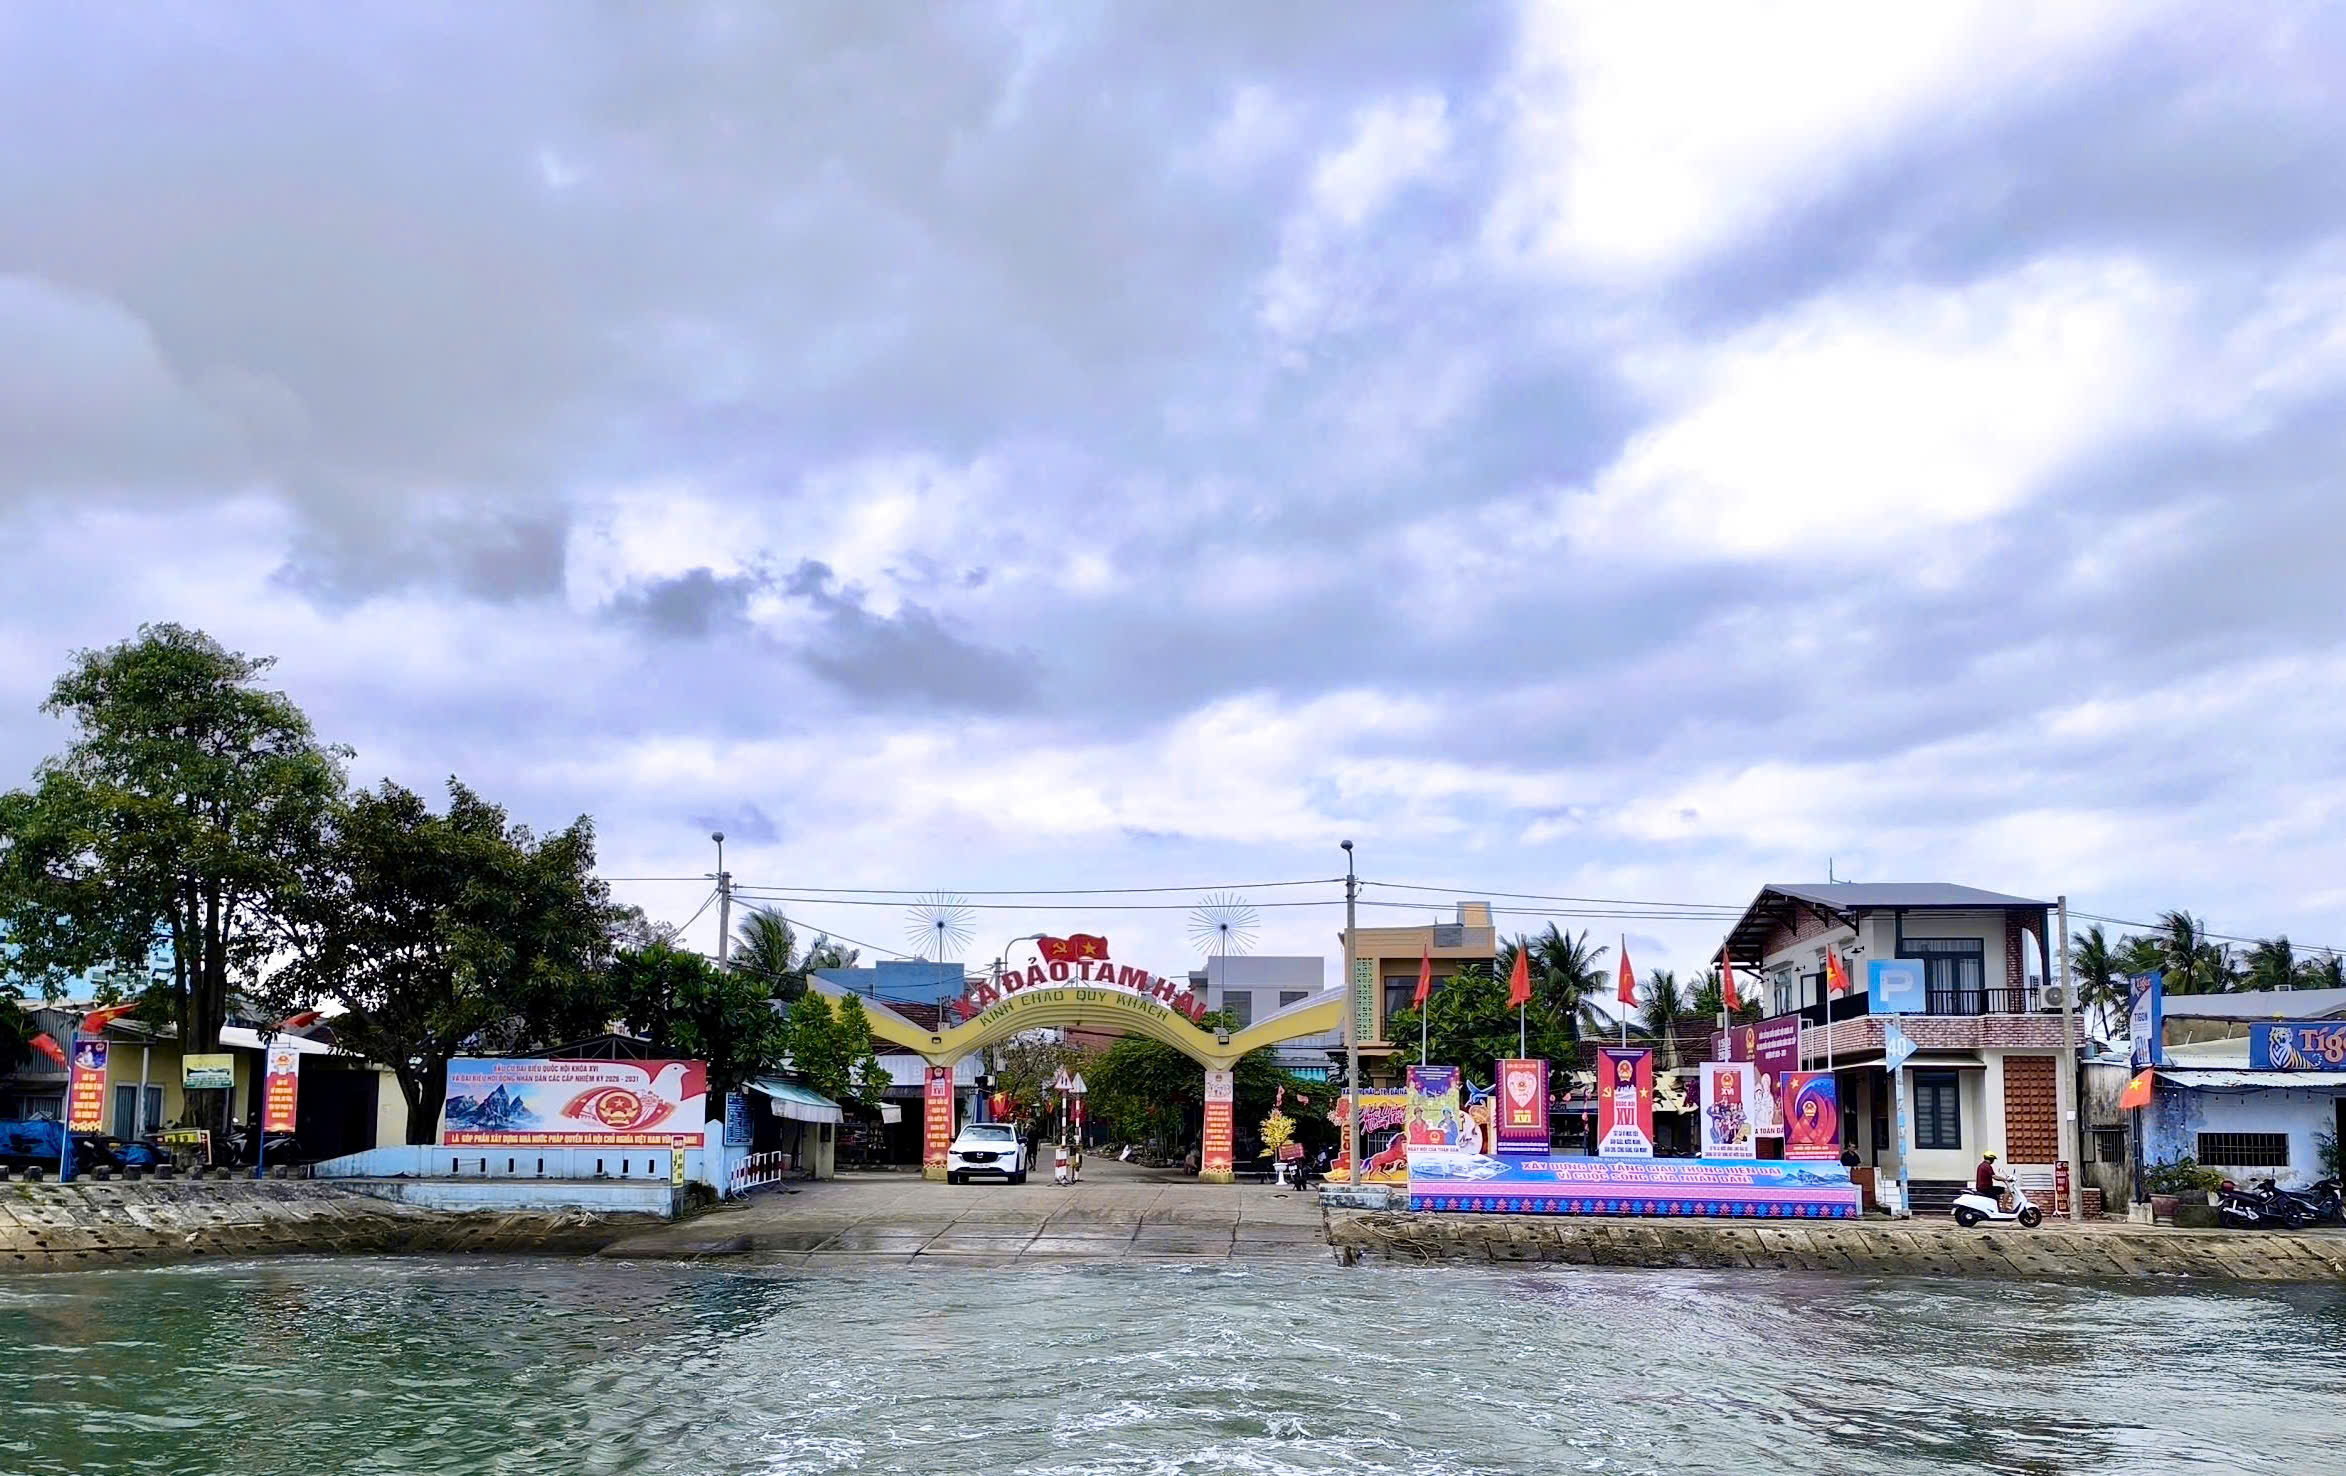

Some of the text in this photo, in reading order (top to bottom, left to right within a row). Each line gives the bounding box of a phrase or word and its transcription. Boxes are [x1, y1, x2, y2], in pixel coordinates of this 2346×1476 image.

[952, 956, 1207, 1023] XÃ ĐẢO TAM HẢI
[1880, 968, 1914, 1002] P
[1888, 1038, 1907, 1057] 40
[548, 1074, 560, 1082] CÁC
[1721, 1088, 1734, 1096] XVI
[1616, 1107, 1635, 1125] XVI
[1523, 1161, 1547, 1170] XÂY
[1646, 1164, 1677, 1173] GIAO
